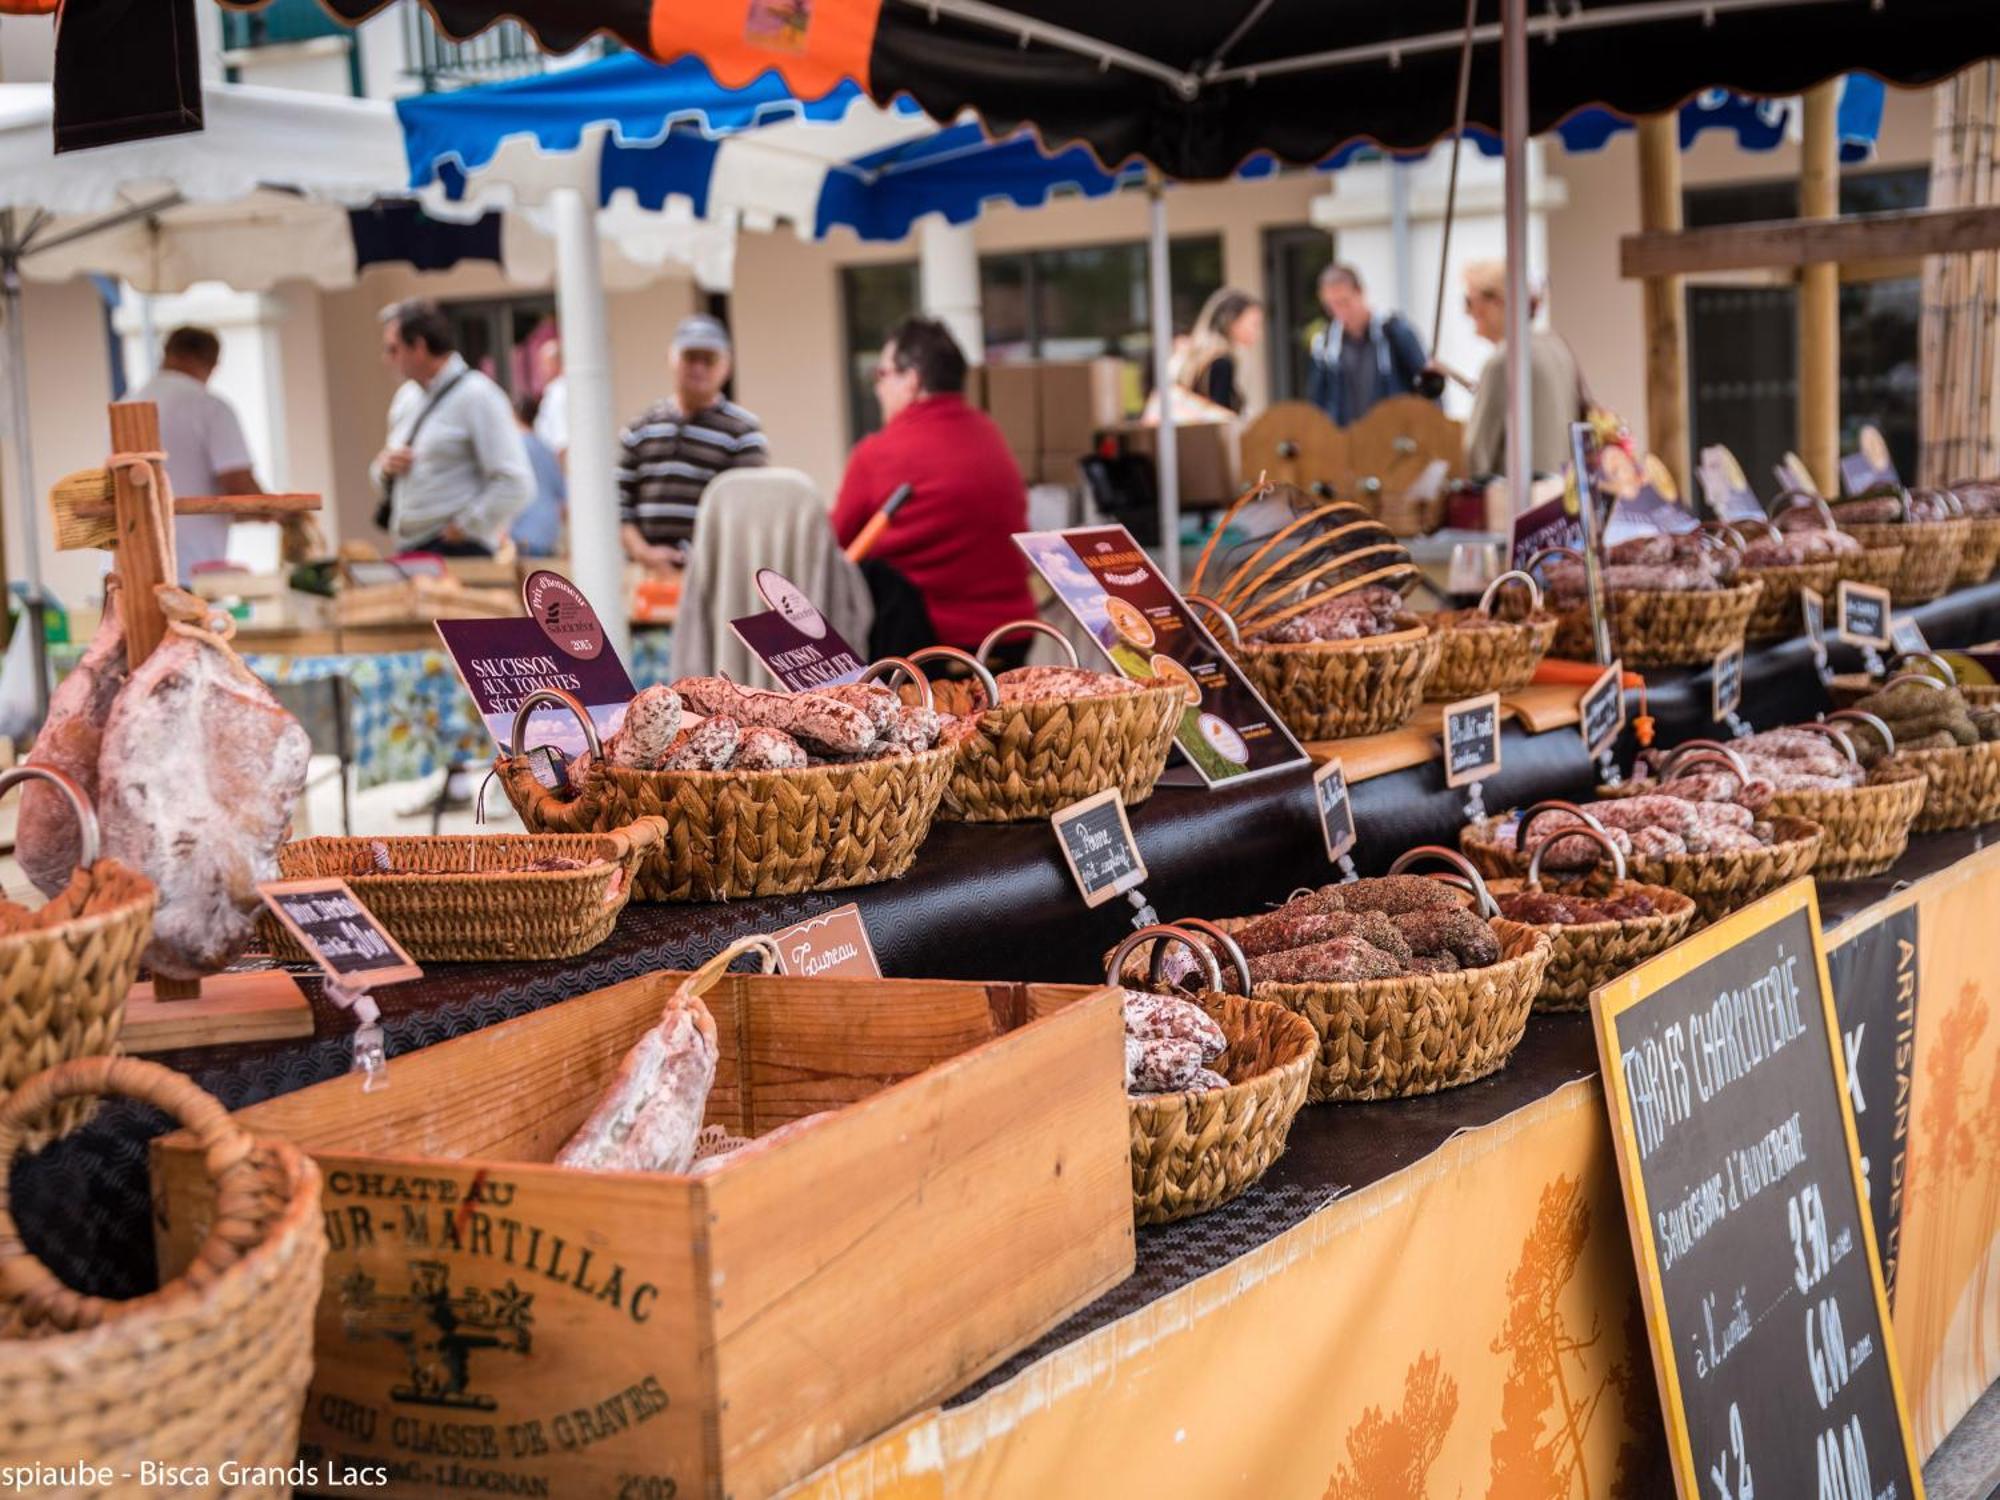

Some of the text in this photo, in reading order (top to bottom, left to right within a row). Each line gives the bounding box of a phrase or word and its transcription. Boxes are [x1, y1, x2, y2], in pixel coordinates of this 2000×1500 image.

[471, 655, 559, 677] SAUCISSON
[482, 673, 581, 695] AUX TOMATES
[1894, 938, 1914, 1141] ARTISAN
[328, 1170, 517, 1206] CHATEAU
[506, 1418, 550, 1459] DE
[552, 1374, 670, 1451] GRAVES
